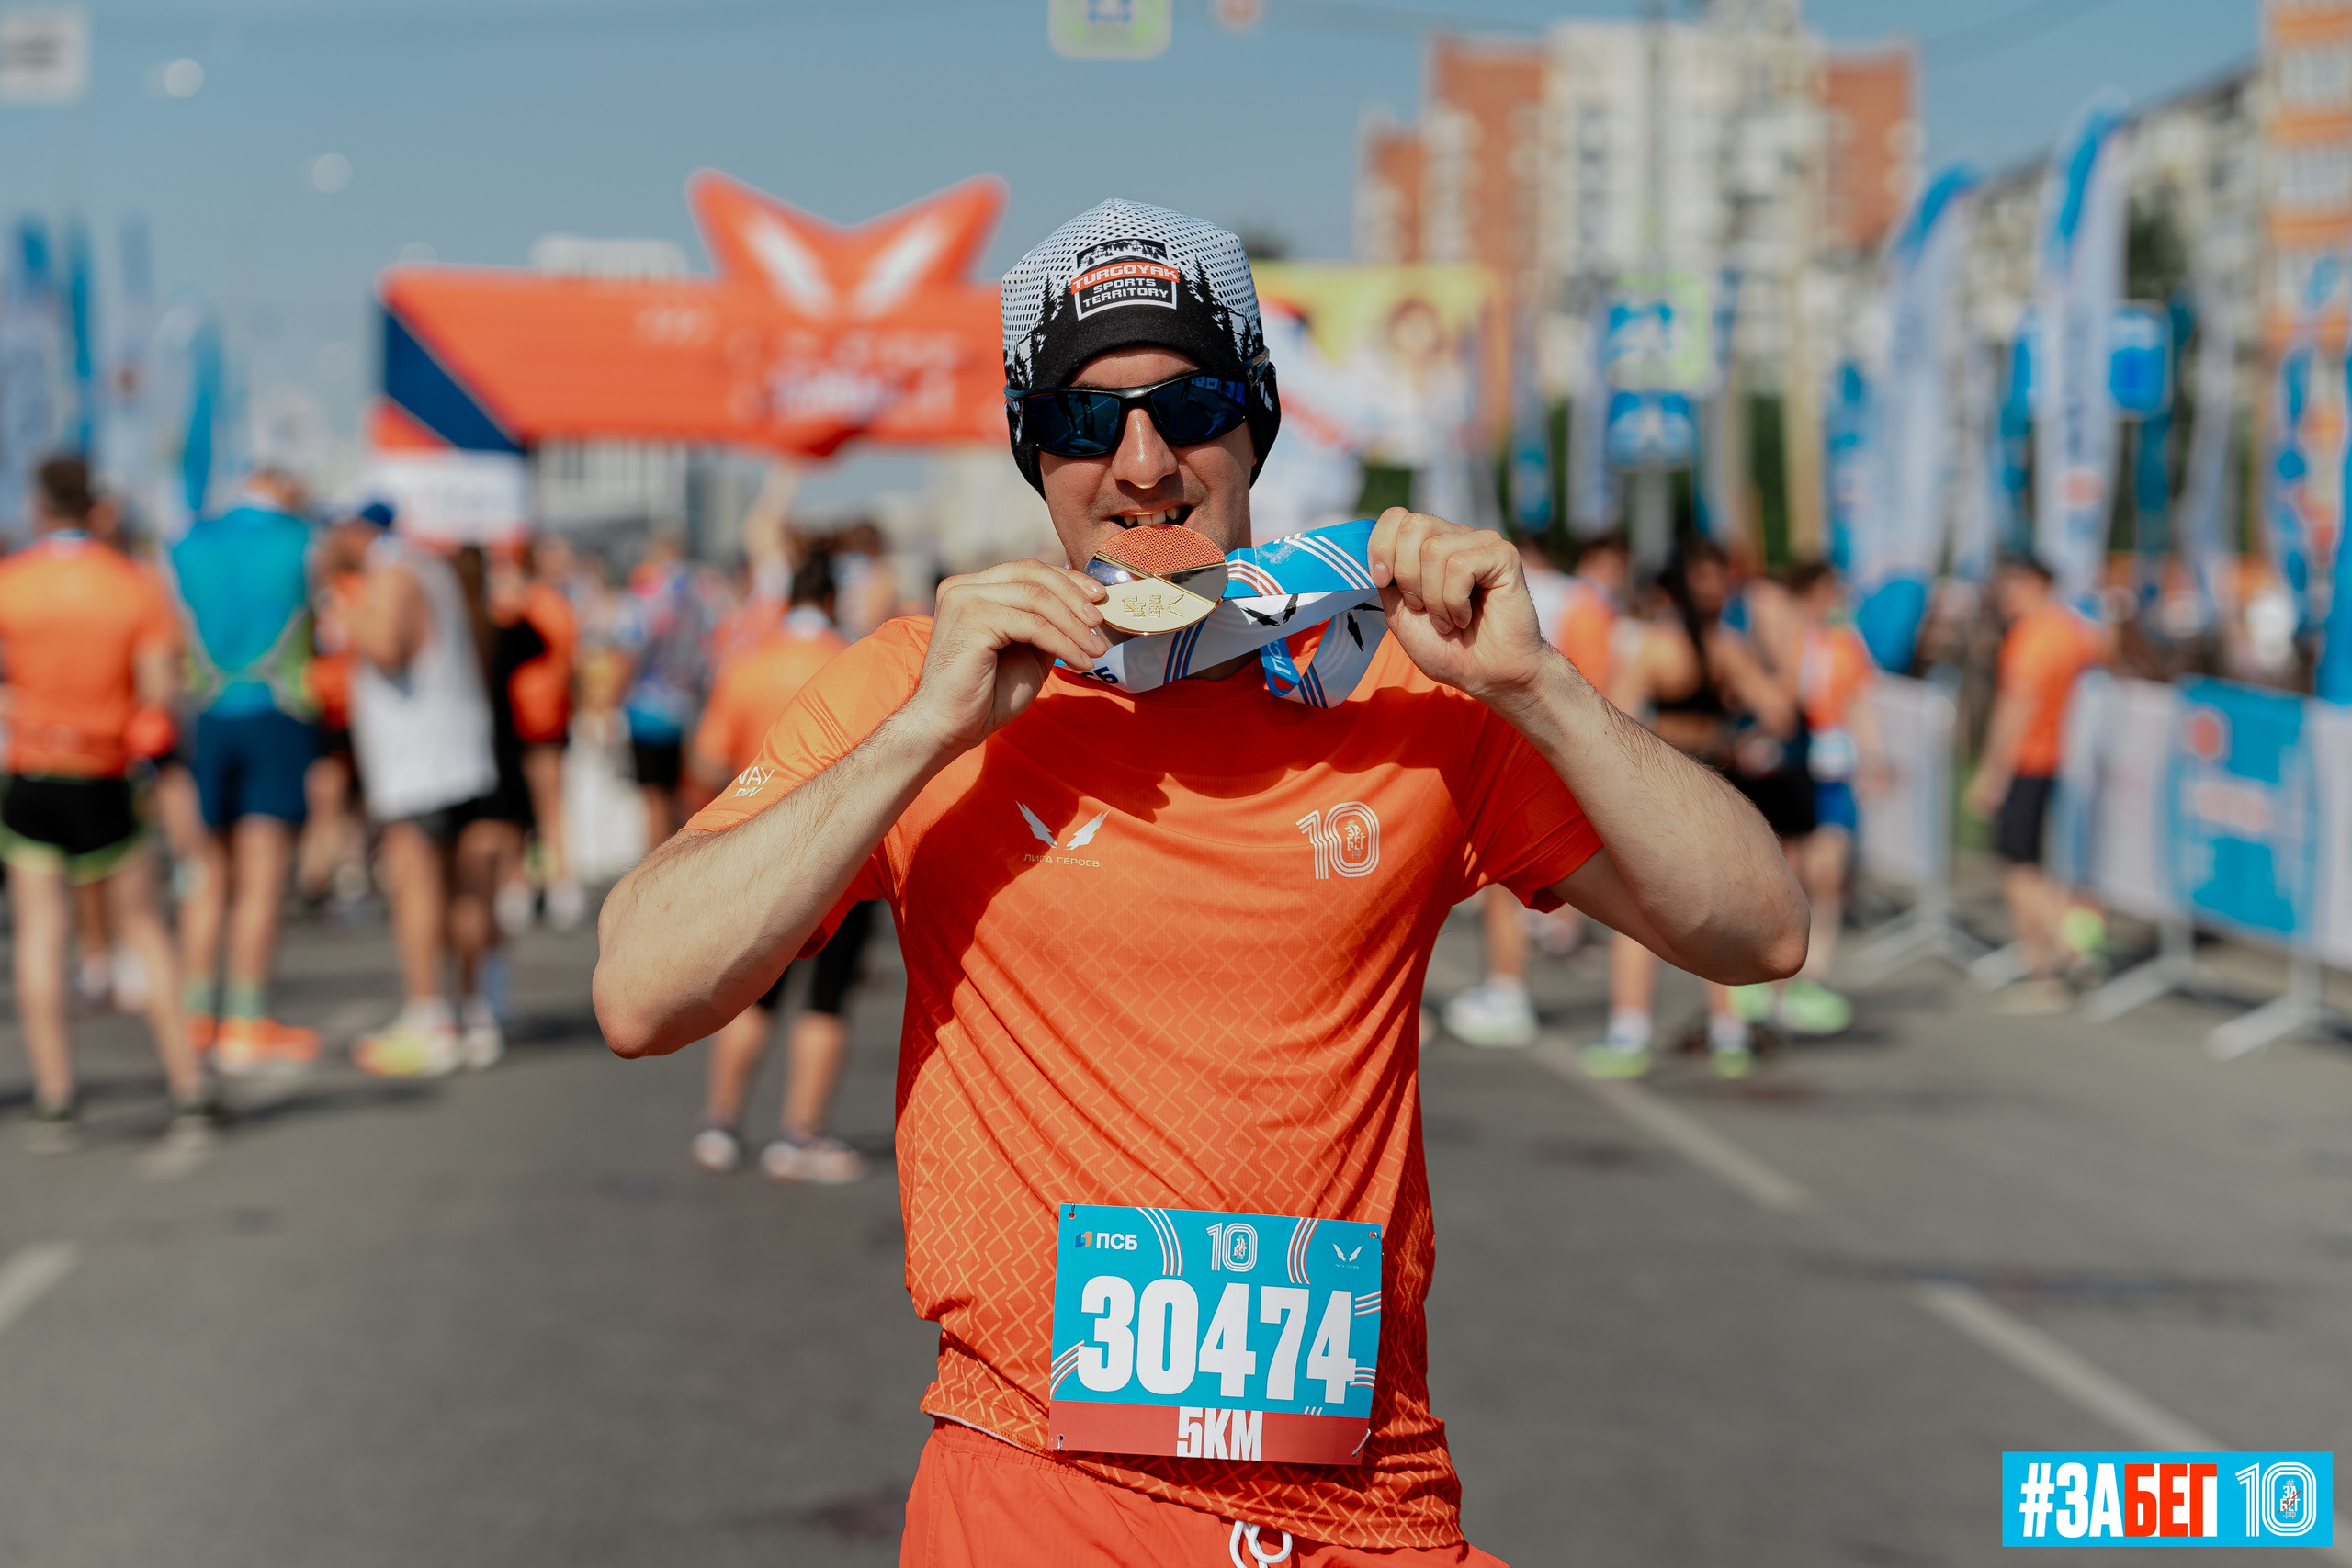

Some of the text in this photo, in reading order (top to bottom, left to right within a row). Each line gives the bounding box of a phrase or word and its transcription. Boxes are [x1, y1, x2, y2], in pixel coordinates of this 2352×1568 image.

[1072, 265, 1178, 290] TURGOYAK
[1093, 277, 1157, 294] SPORTS
[1082, 288, 1169, 308] TERRITORY
[1295, 799, 1380, 881] 10
[1023, 853, 1100, 867] ЛИГА ГЕРОЕВ
[1096, 1232, 1138, 1251] ПСБ
[1205, 1222, 1259, 1272] 10
[1077, 1275, 1357, 1404] 30474
